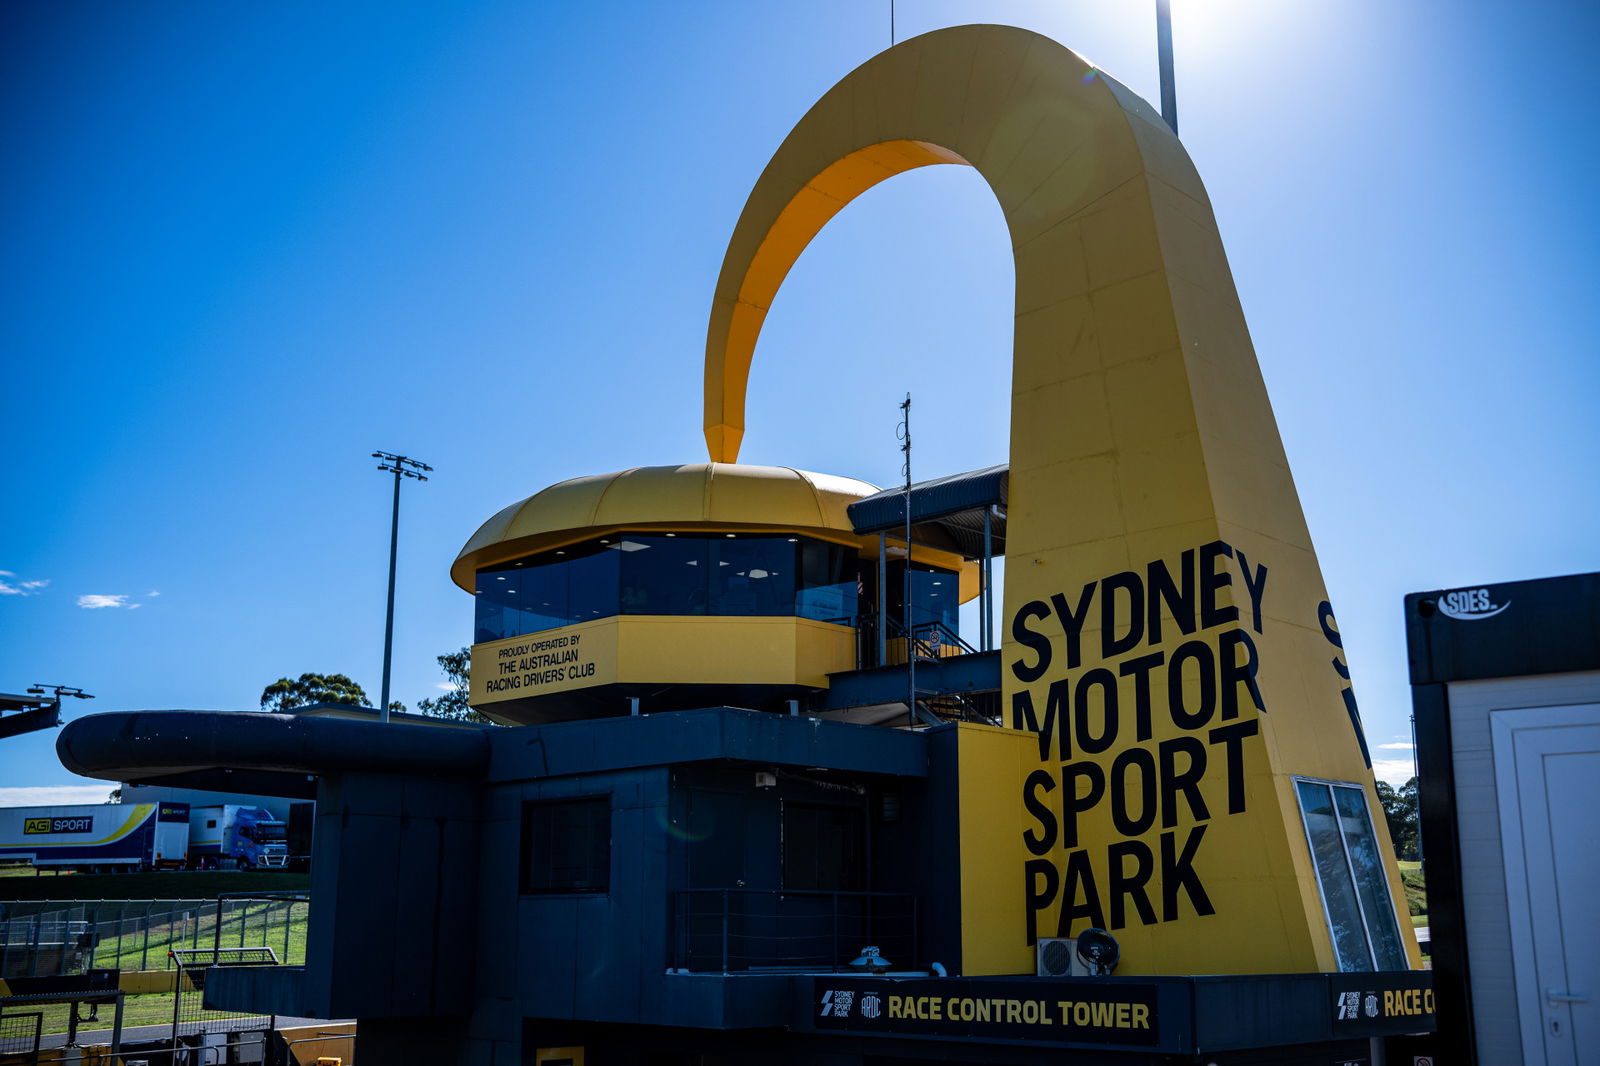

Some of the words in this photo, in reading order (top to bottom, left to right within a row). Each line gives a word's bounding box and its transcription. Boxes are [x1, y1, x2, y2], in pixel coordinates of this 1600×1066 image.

[1011, 540, 1267, 682] SYDNEY
[499, 644, 529, 659] PROUDLY
[531, 637, 568, 653] OPERATED
[571, 635, 580, 646] BY
[499, 660, 516, 675] THE
[519, 649, 578, 671] AUSTRALIAN
[487, 676, 520, 693] RACING
[524, 666, 566, 687] DRIVERS'
[569, 663, 595, 679] CLUB
[1012, 628, 1267, 762] MOTOR
[1023, 719, 1258, 855] SPORT
[54, 819, 90, 831] SPORT
[1025, 824, 1216, 946] PARK
[888, 995, 942, 1020] RACE
[947, 997, 1052, 1025] CONTROL
[1057, 1001, 1150, 1029] TOWER
[1384, 989, 1422, 1016] RACE
